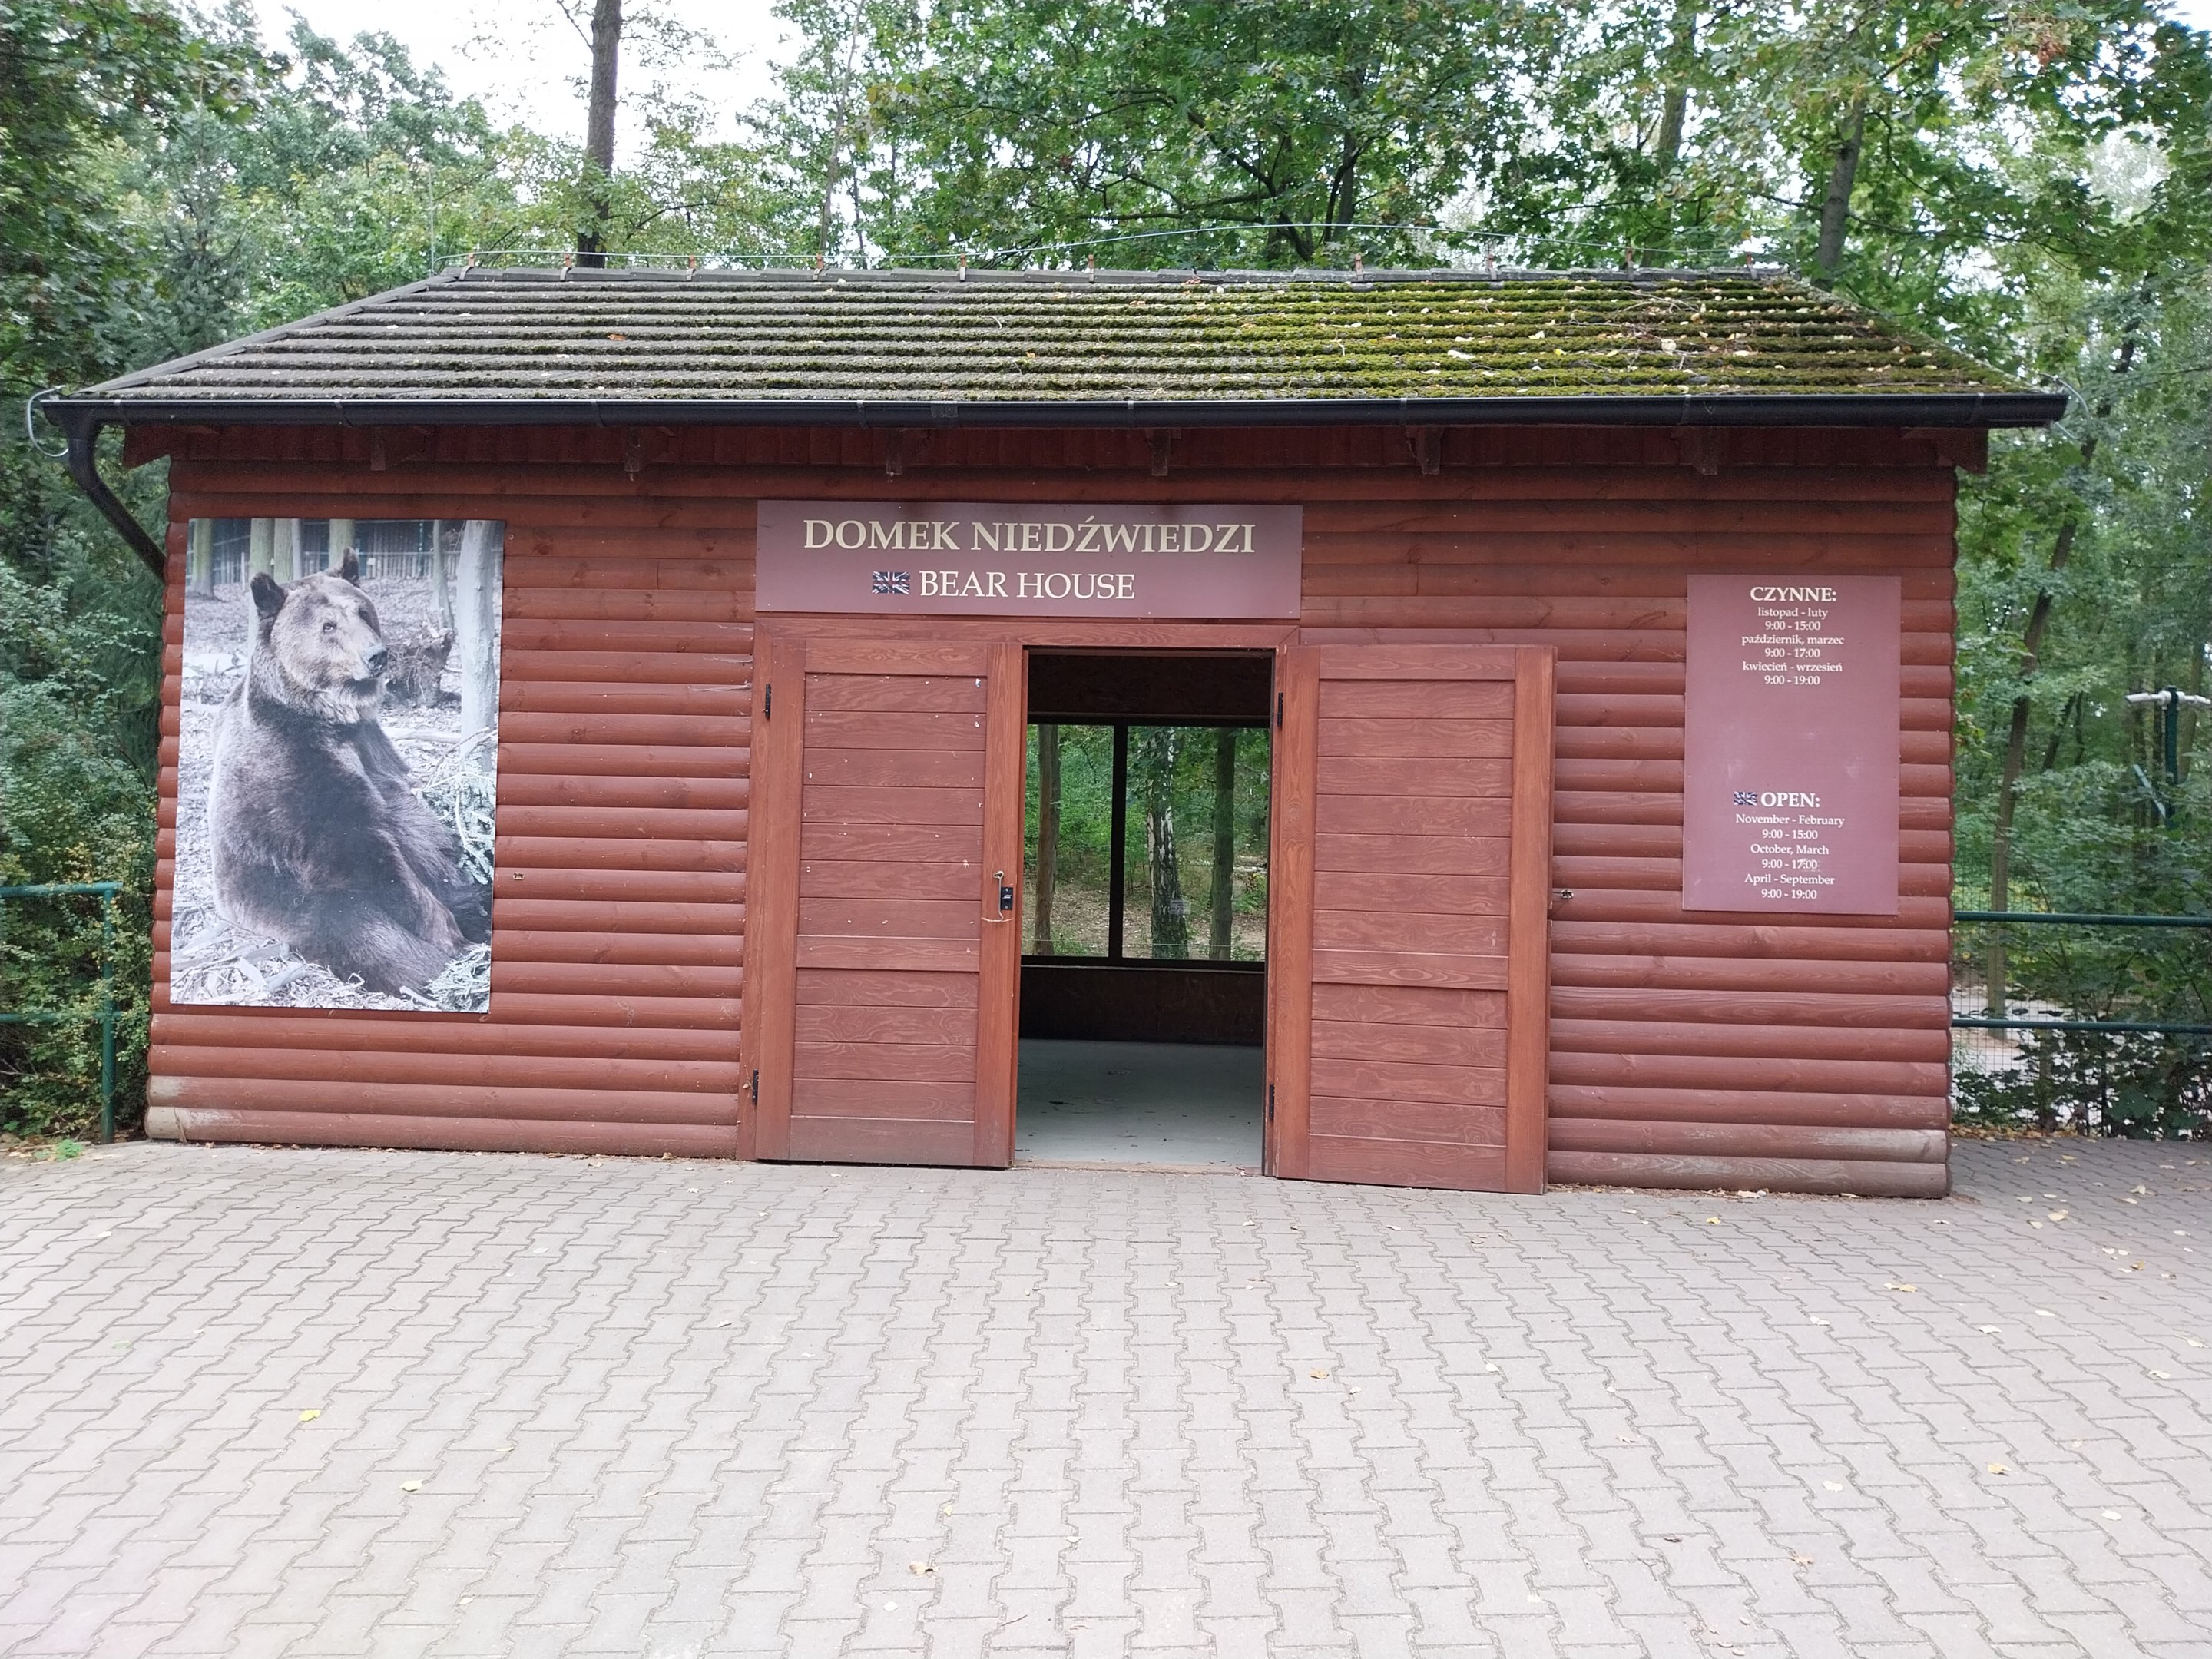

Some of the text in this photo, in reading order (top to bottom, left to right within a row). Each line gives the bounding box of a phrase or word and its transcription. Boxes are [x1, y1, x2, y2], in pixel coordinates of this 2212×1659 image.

[803, 515, 1256, 553] DOMEK NIEDŹWIEDZI
[919, 571, 1135, 599] BEAR HOUSE
[1750, 586, 1836, 602] CZYNNE:
[1757, 606, 1799, 620] listopad
[1807, 607, 1829, 620] luty
[1764, 620, 1786, 631] 9:00
[1794, 621, 1821, 631] 15:00
[1741, 634, 1805, 646] październik,
[1764, 647, 1786, 657] 9:00
[1793, 647, 1820, 658] 17:00
[1743, 661, 1788, 671] kwiecień
[1796, 662, 1843, 672] wrzesień
[1763, 674, 1785, 685] 9:00
[1793, 675, 1820, 685] 19:00
[1760, 792, 1820, 808] OPEN:
[1735, 813, 1790, 824] November
[1798, 814, 1845, 828] February
[1762, 829, 1783, 839] 9:00
[1792, 830, 1818, 839] 15:00
[1750, 843, 1830, 856] October, March
[1761, 859, 1783, 869] 9:00
[1792, 858, 1818, 869] 17:00
[1744, 873, 1772, 886] April
[1780, 873, 1836, 887] September
[1760, 889, 1783, 899] 9:00
[1791, 889, 1817, 899] 19:00
